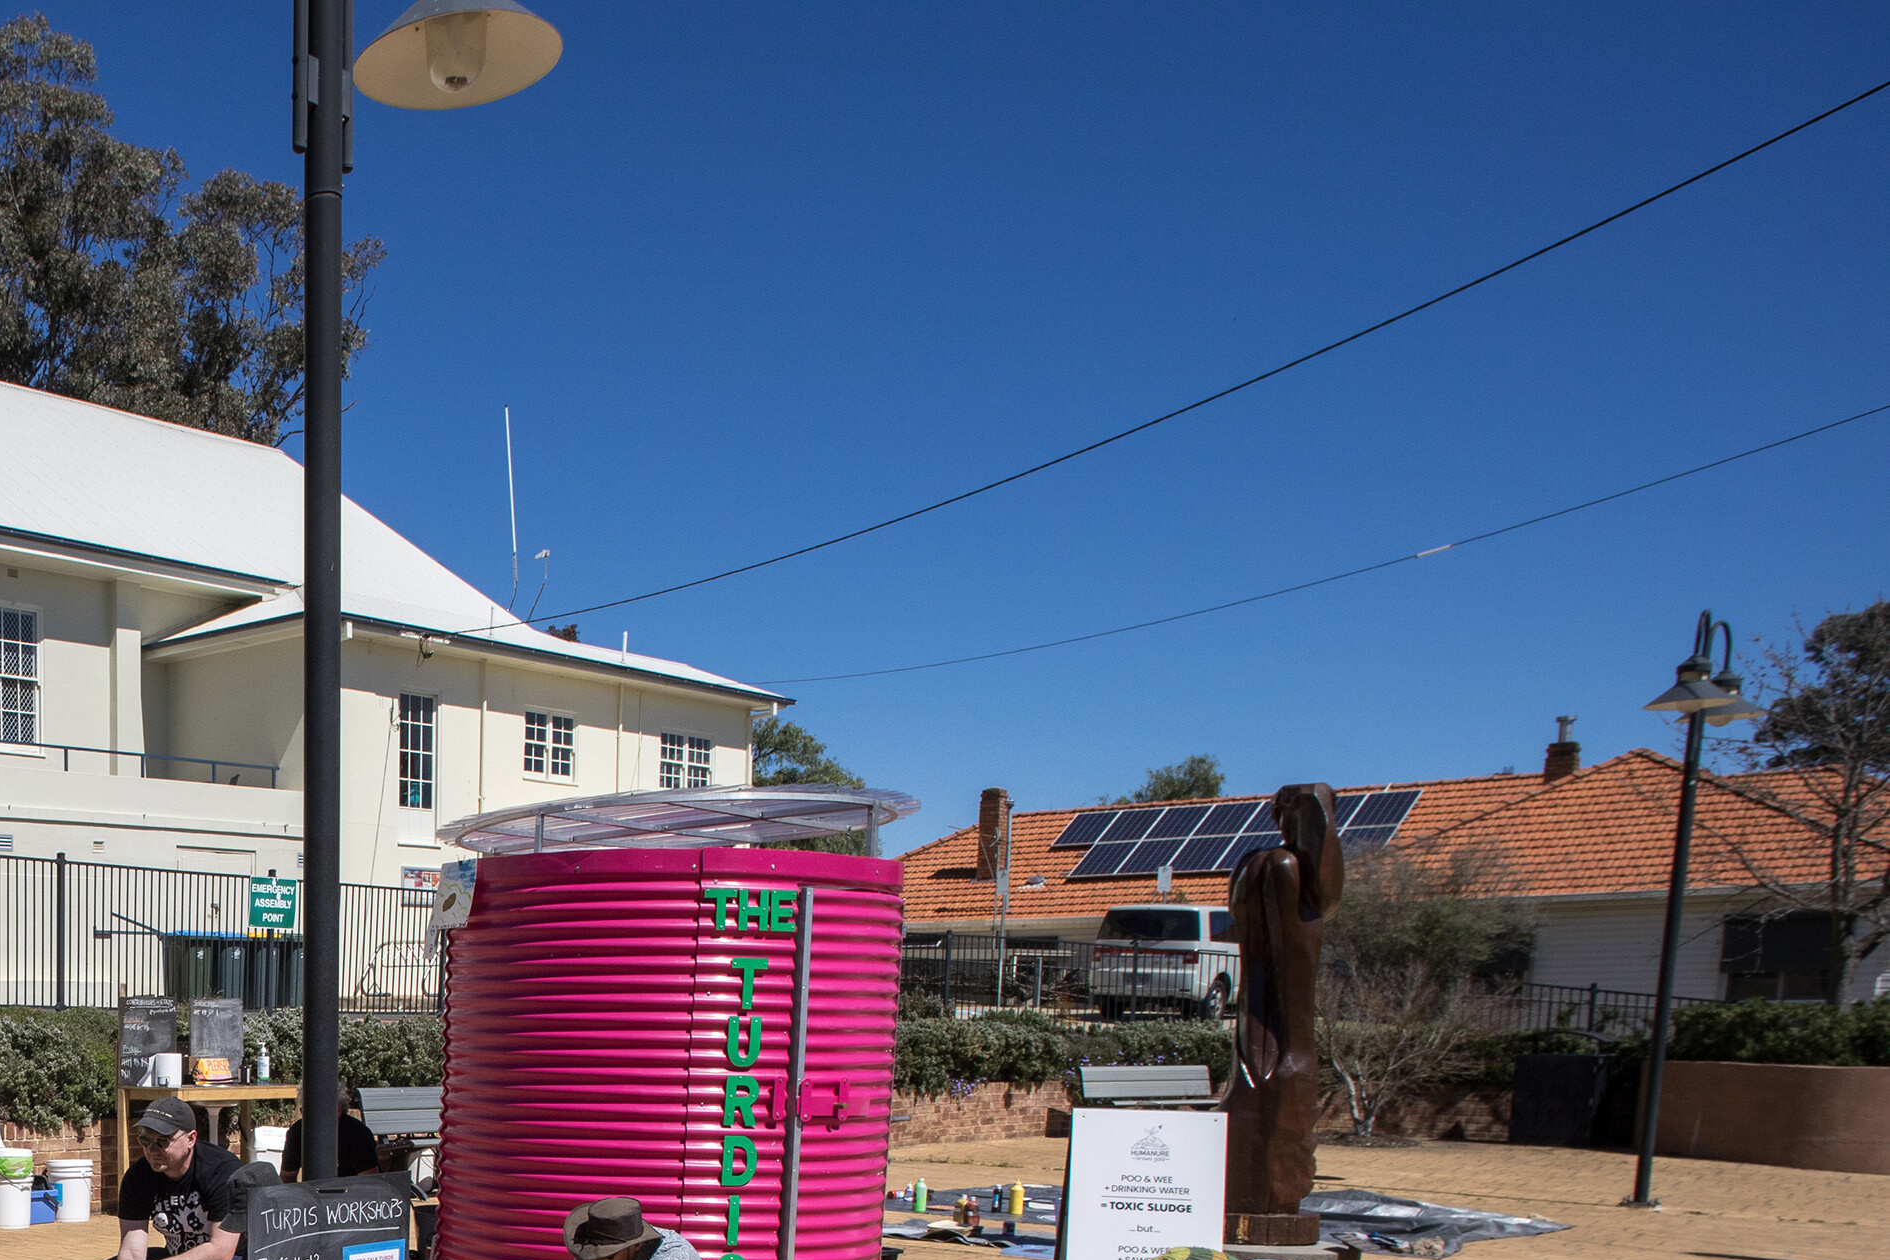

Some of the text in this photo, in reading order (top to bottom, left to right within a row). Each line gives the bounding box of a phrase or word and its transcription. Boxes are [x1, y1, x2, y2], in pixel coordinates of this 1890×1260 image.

[251, 883, 295, 895] EMERGENCY
[254, 898, 292, 909] ASSEMBLY
[704, 889, 797, 931] THE
[262, 913, 284, 923] POINT
[1121, 1174, 1173, 1184] POO & WEE
[1111, 1184, 1157, 1194] DRINKING
[1159, 1186, 1190, 1195] WATER
[1109, 1201, 1144, 1211] TOXIC
[1147, 1202, 1192, 1214] SLUDGE
[261, 1199, 403, 1235] TURDIS WORKSHOPS
[1118, 1245, 1139, 1253] POO
[1141, 1246, 1148, 1254] &
